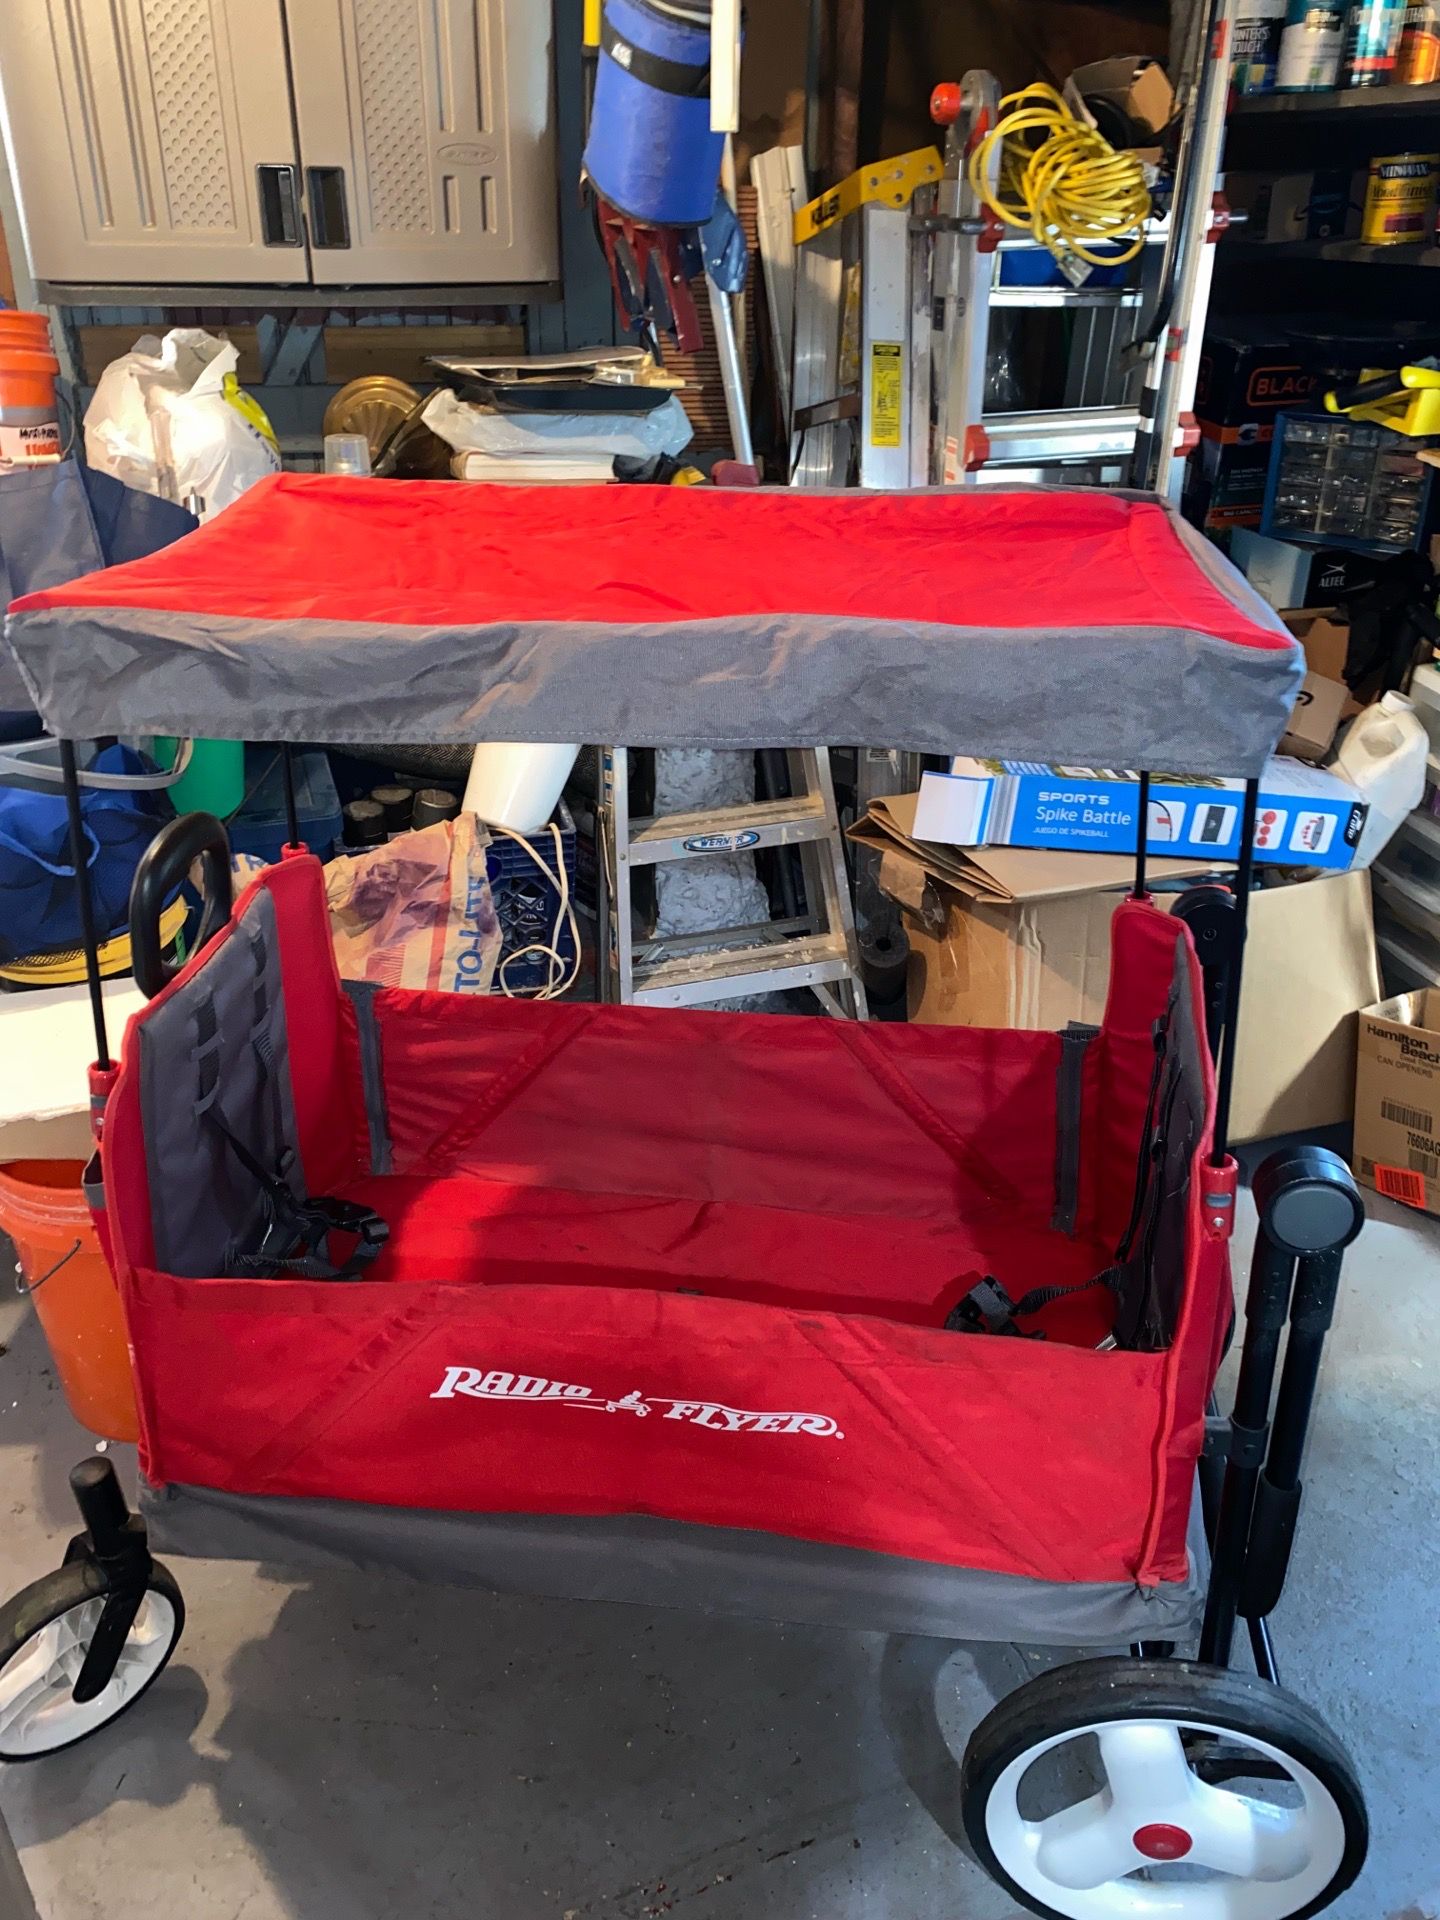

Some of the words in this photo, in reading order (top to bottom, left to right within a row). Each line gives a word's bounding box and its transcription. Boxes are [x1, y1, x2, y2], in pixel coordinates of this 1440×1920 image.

[1038, 792, 1110, 805] SPORTS
[1035, 806, 1078, 824] Spike
[1082, 809, 1132, 825] Battle
[701, 835, 744, 847] WERNR
[1033, 826, 1057, 835] JUEGO
[1070, 828, 1109, 838] SPIKEBALL
[1367, 1023, 1428, 1051] Hamilton
[1376, 1055, 1394, 1067] CAN
[1395, 1060, 1433, 1079] OPENERS
[430, 1366, 594, 1400] RADIO
[663, 1400, 838, 1437] FLYER
